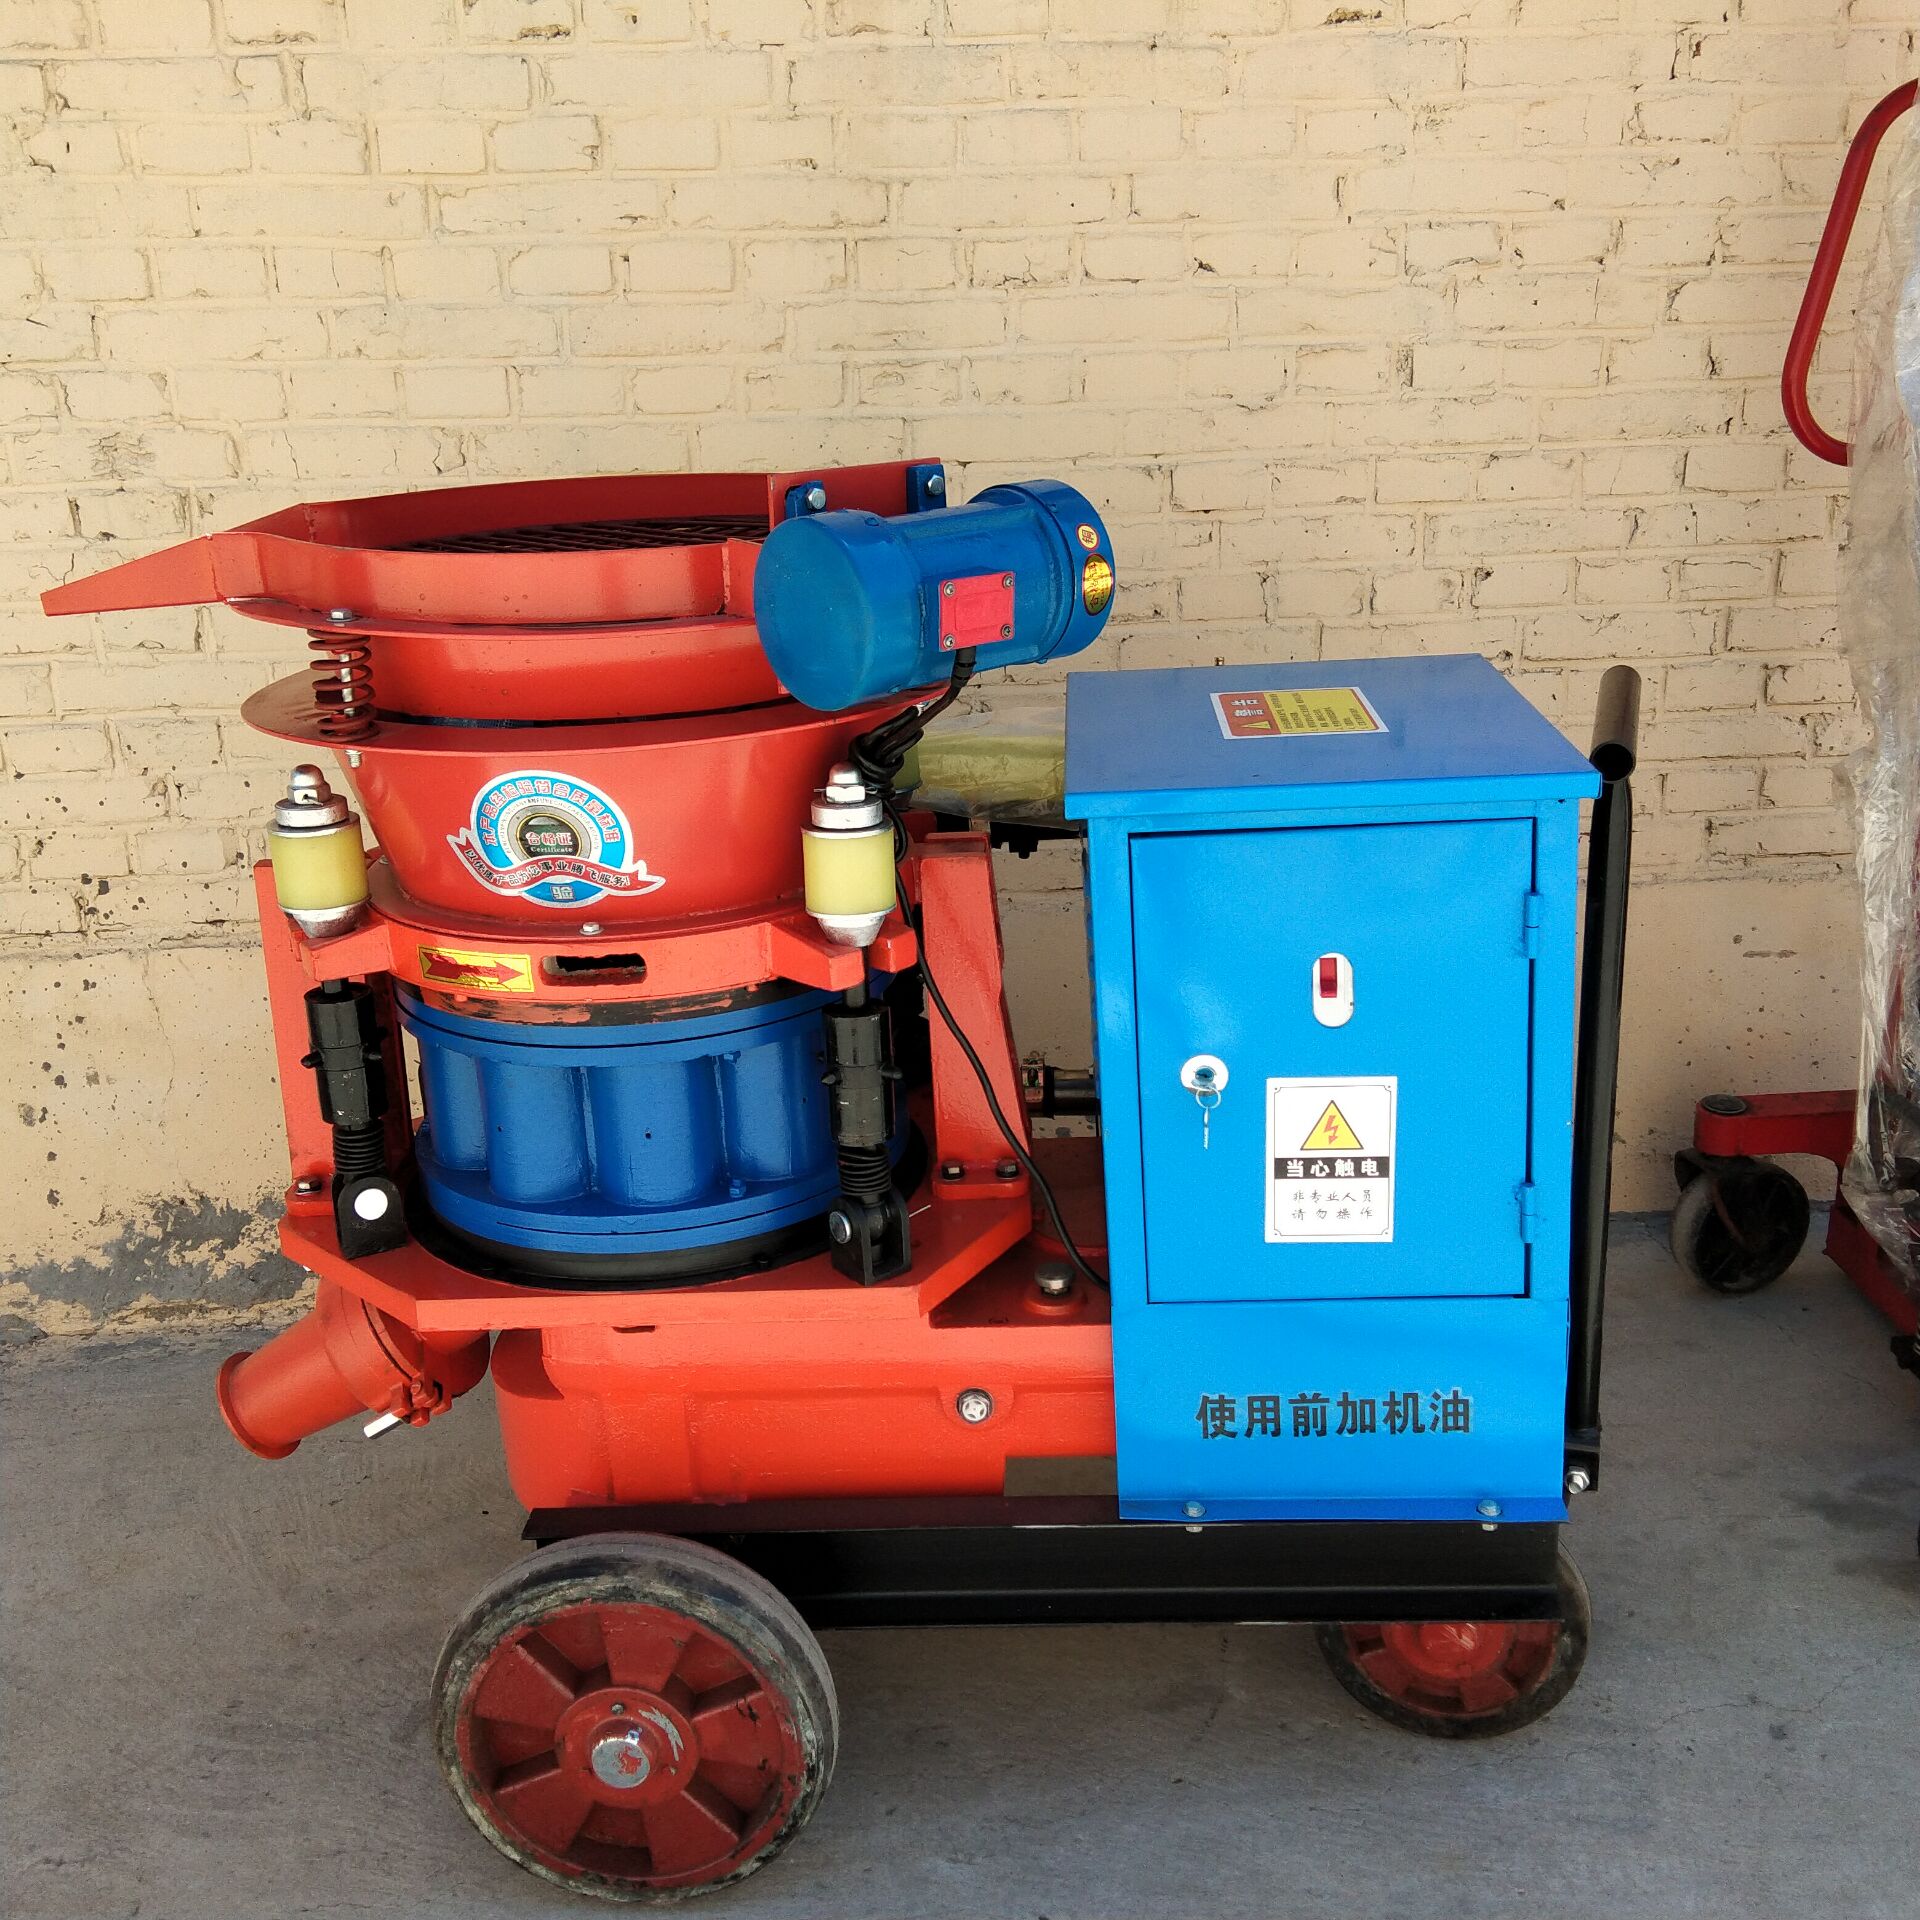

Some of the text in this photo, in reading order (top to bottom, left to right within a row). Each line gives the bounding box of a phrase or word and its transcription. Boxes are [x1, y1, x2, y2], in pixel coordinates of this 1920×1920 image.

[480, 779, 621, 847] 本产品经检验符合质量标准
[525, 831, 573, 846] 合格证
[530, 846, 573, 854] Certificate
[552, 885, 574, 900] 验
[1286, 1158, 1380, 1178] 当心触电
[1292, 1189, 1373, 1204] 非专业人员
[1291, 1208, 1375, 1221] 请勿操作
[1195, 1390, 1471, 1439] 使用前加机油
